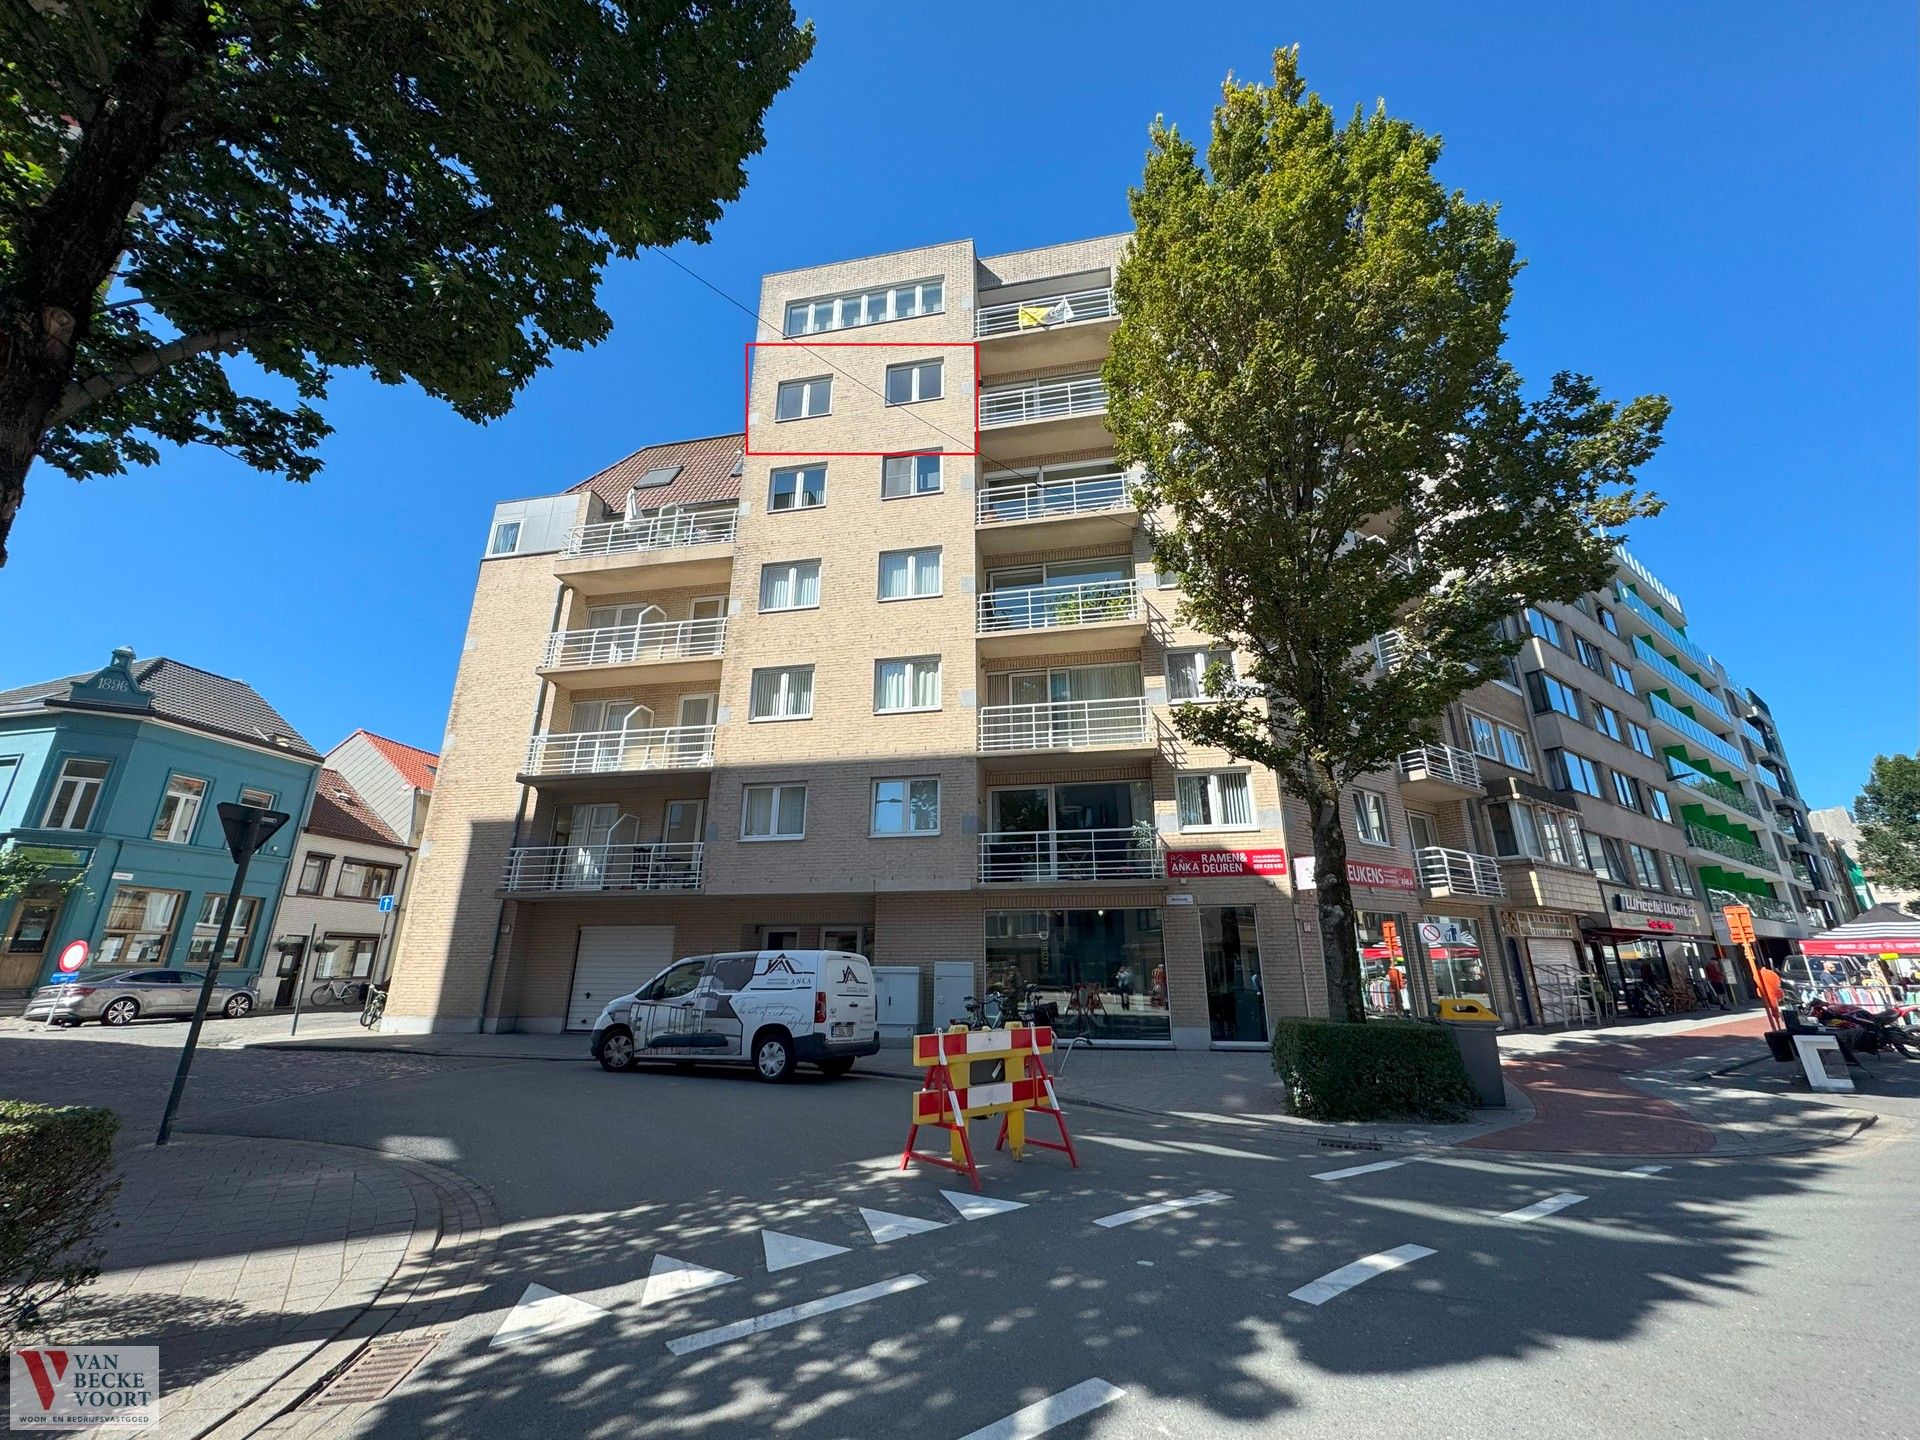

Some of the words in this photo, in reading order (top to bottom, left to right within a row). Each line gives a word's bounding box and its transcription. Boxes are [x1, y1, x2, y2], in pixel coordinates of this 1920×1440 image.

[98, 677, 128, 692] 1896
[1201, 852, 1248, 863] RAMEN&
[1171, 863, 1200, 872] ANKA
[1202, 863, 1243, 873] DEUREN
[1346, 864, 1384, 884] EUKENS
[790, 977, 812, 985] ANKA
